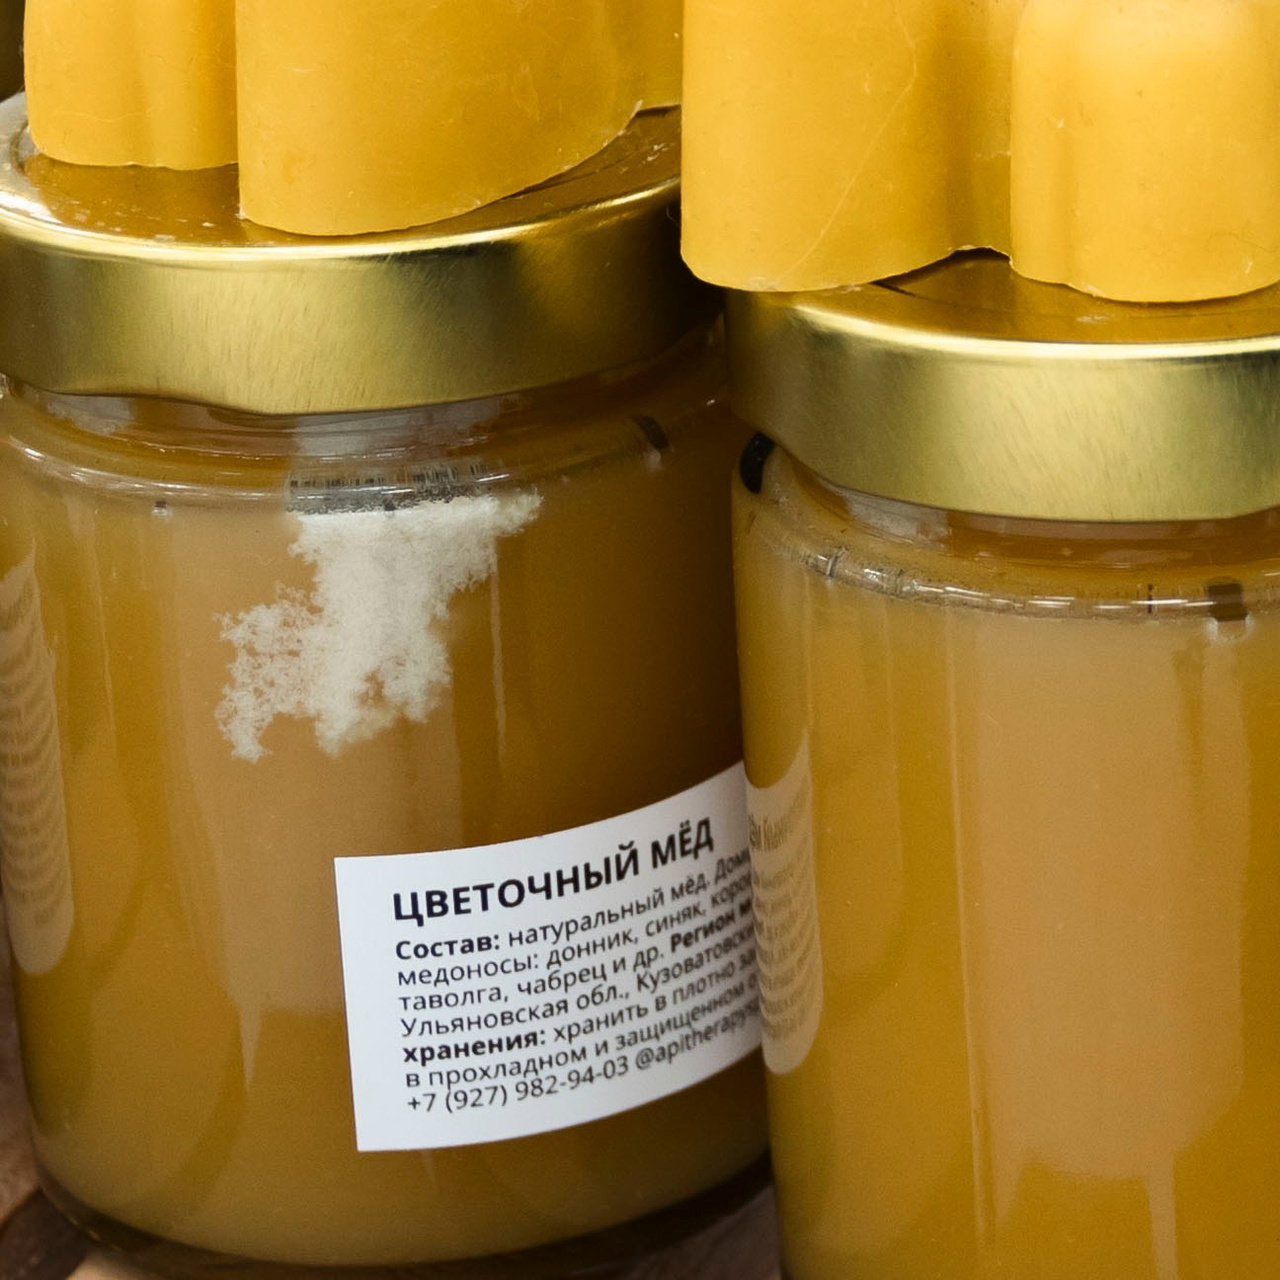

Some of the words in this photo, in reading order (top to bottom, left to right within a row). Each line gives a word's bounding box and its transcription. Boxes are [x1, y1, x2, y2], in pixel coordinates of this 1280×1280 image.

[392, 839, 640, 928] ЦВЕТОЧНЫЙ
[650, 816, 714, 870] МЁД
[395, 932, 501, 961] Состав:
[508, 886, 666, 948] натуральный
[670, 872, 711, 902] мёд.
[397, 953, 540, 988] медоносы:
[546, 928, 639, 969] донник,
[645, 902, 707, 937] синяк,
[398, 986, 509, 1011] таволга,
[517, 966, 608, 997] чабрец
[612, 957, 627, 973] и
[632, 945, 665, 973] др.
[670, 910, 736, 953] Регион
[400, 998, 569, 1038] Ульяновская
[576, 983, 630, 1011] обл.,
[402, 1028, 546, 1067] хранения:
[553, 1003, 649, 1045] хранить
[654, 995, 667, 1012] в
[671, 959, 736, 1005] плотно
[405, 1073, 421, 1089] в
[428, 1046, 587, 1090] прохладном
[594, 1040, 609, 1056] и
[615, 976, 746, 1051] защищенном
[406, 1092, 437, 1113] +7
[444, 1084, 508, 1114] (927)
[515, 1054, 629, 1102] 982-94-03
